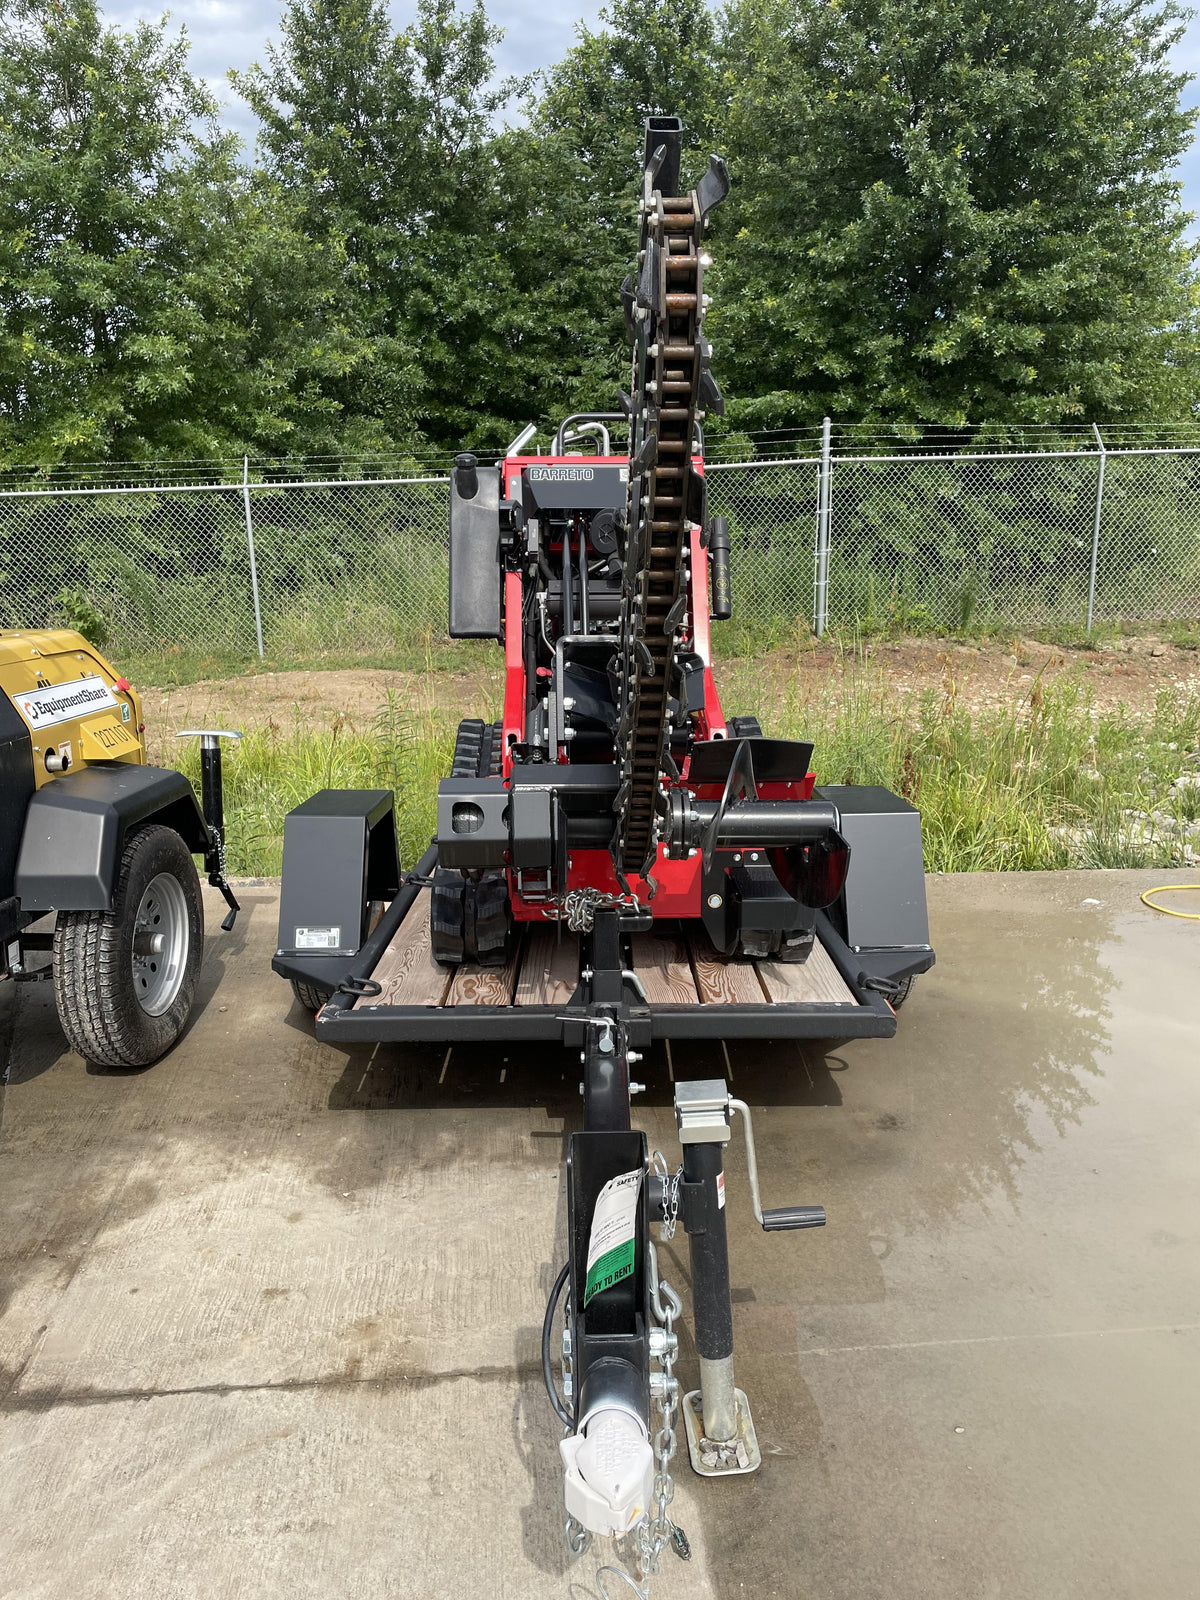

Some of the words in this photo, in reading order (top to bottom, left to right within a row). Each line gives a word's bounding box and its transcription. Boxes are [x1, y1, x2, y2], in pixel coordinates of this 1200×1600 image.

[530, 468, 594, 481] BARRETO
[34, 687, 108, 715] EquipmentShare
[93, 725, 132, 747] 227107
[604, 1275, 613, 1287] TO
[614, 1263, 632, 1281] RENT
